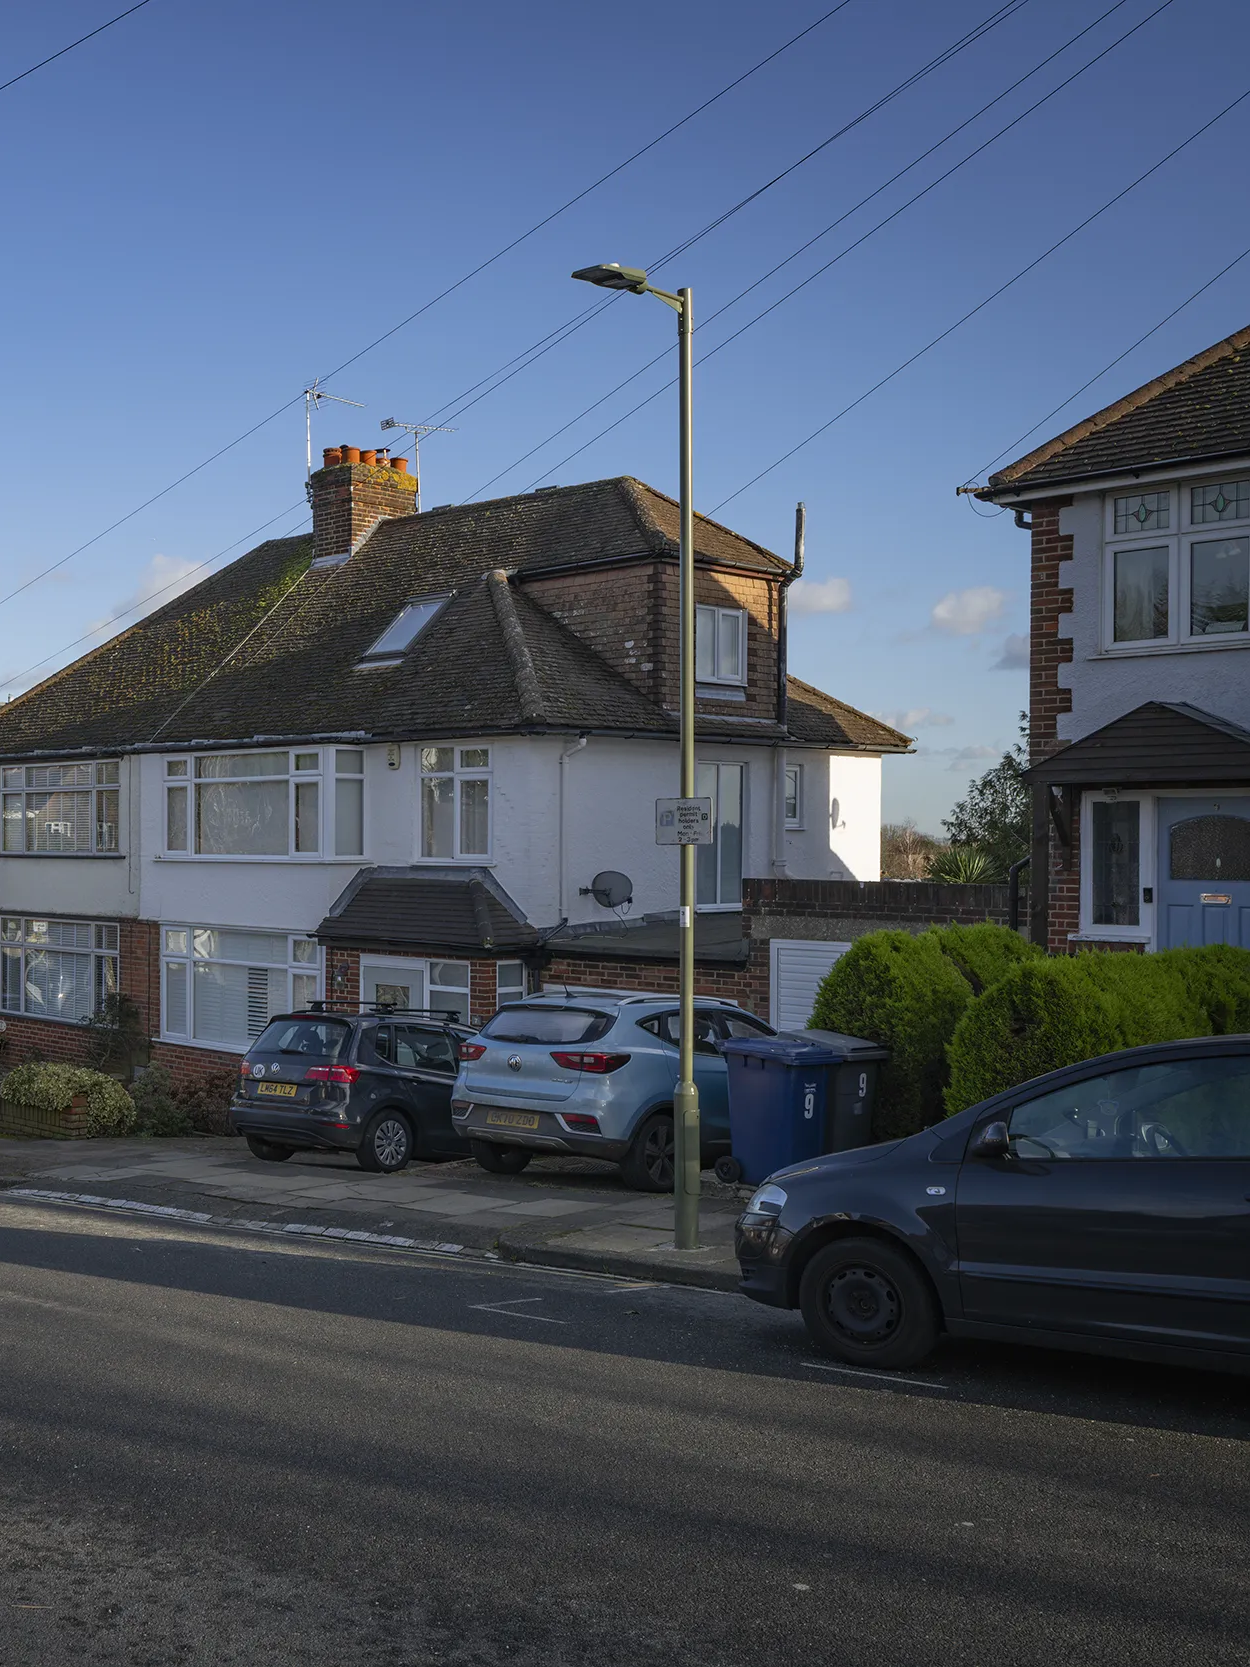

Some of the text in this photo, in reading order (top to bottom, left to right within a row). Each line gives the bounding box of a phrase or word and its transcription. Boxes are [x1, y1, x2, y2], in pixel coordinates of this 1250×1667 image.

[663, 813, 671, 826] P
[255, 1066, 264, 1076] UK
[279, 1084, 294, 1095] TLZ
[859, 1072, 867, 1097] 9
[804, 1093, 814, 1119] 9
